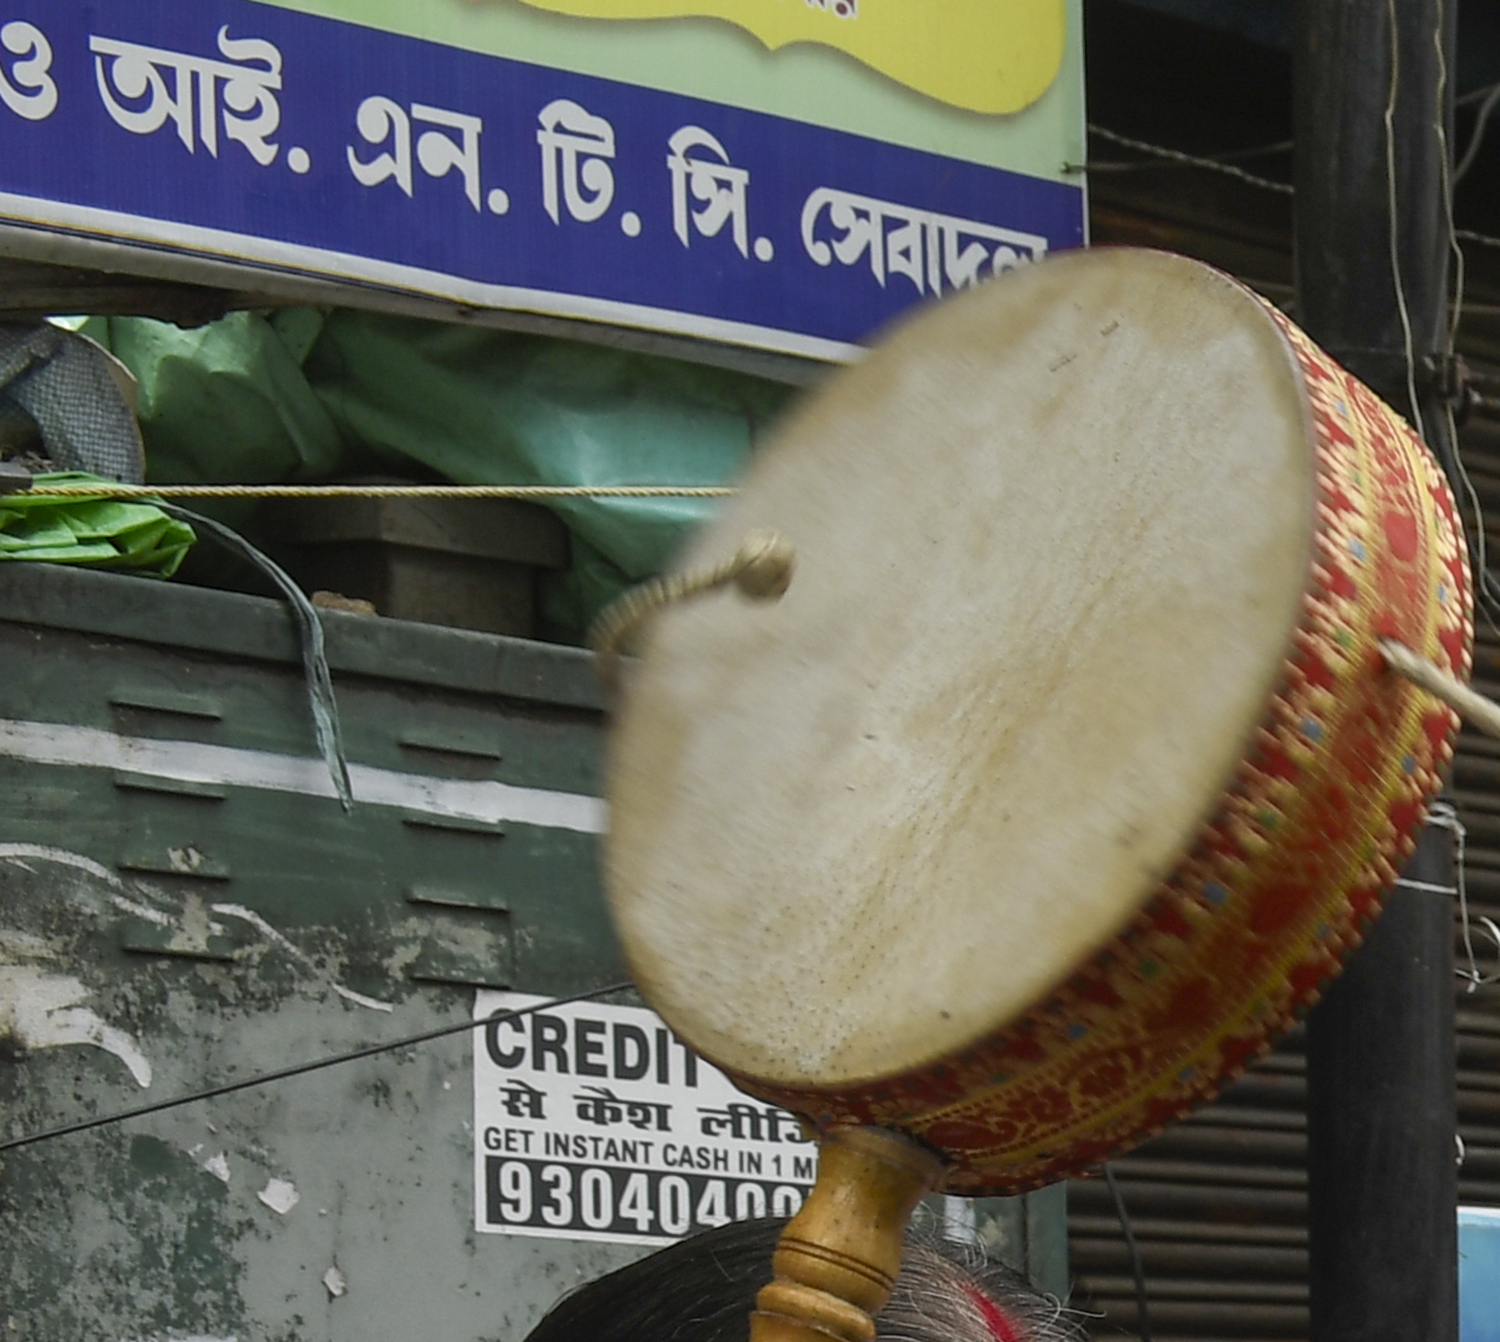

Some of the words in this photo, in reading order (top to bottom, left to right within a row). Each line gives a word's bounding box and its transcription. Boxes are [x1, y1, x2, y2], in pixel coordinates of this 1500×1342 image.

[89, 24, 311, 174] আই.
[346, 95, 510, 214] এন.
[538, 98, 642, 238] টি.
[667, 124, 774, 262] সি.
[499, 1079, 547, 1120] से
[573, 1085, 673, 1132] कैश
[484, 1127, 534, 1153] GET
[545, 1132, 654, 1165] INSTANT
[663, 1144, 730, 1172] CASH
[739, 1152, 763, 1175] IN
[772, 1154, 782, 1177] 1
[794, 1156, 818, 1180] M
